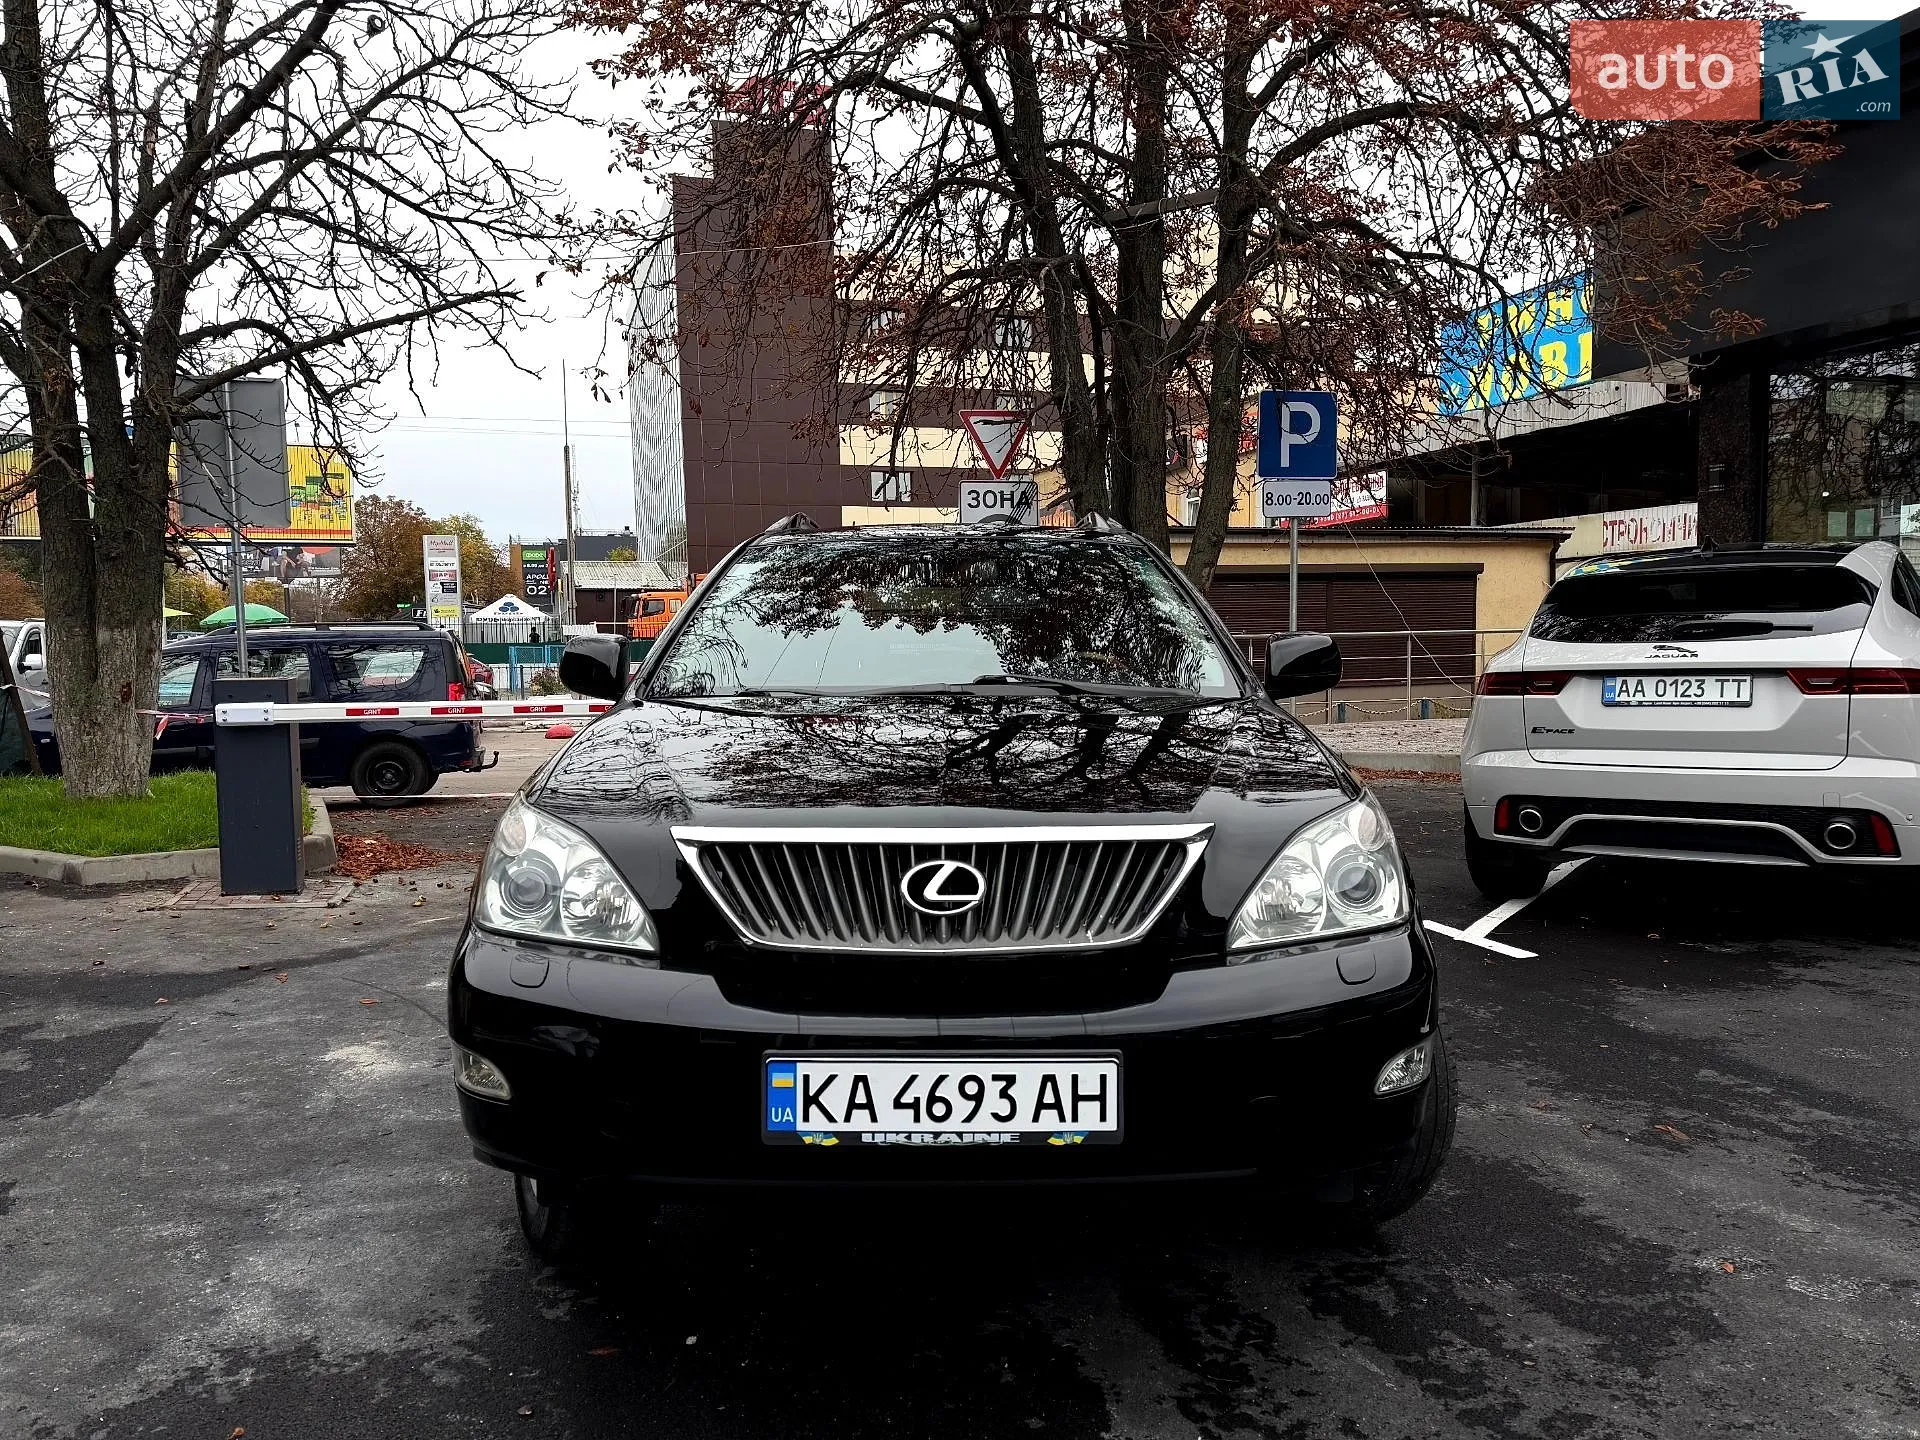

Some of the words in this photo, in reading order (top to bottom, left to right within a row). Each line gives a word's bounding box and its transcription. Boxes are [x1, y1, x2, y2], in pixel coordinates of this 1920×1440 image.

[967, 489, 1031, 510] ЗОНА
[1265, 491, 1330, 506] 8.00-20.00
[1617, 679, 1646, 698] AA
[1654, 679, 1706, 698] 0123
[1715, 679, 1747, 698] TT
[771, 1108, 794, 1123] UA
[802, 1074, 878, 1123] KA
[893, 1074, 1018, 1123] 4693
[1031, 1074, 1107, 1123] AH
[861, 1133, 1021, 1144] UKRAINE
